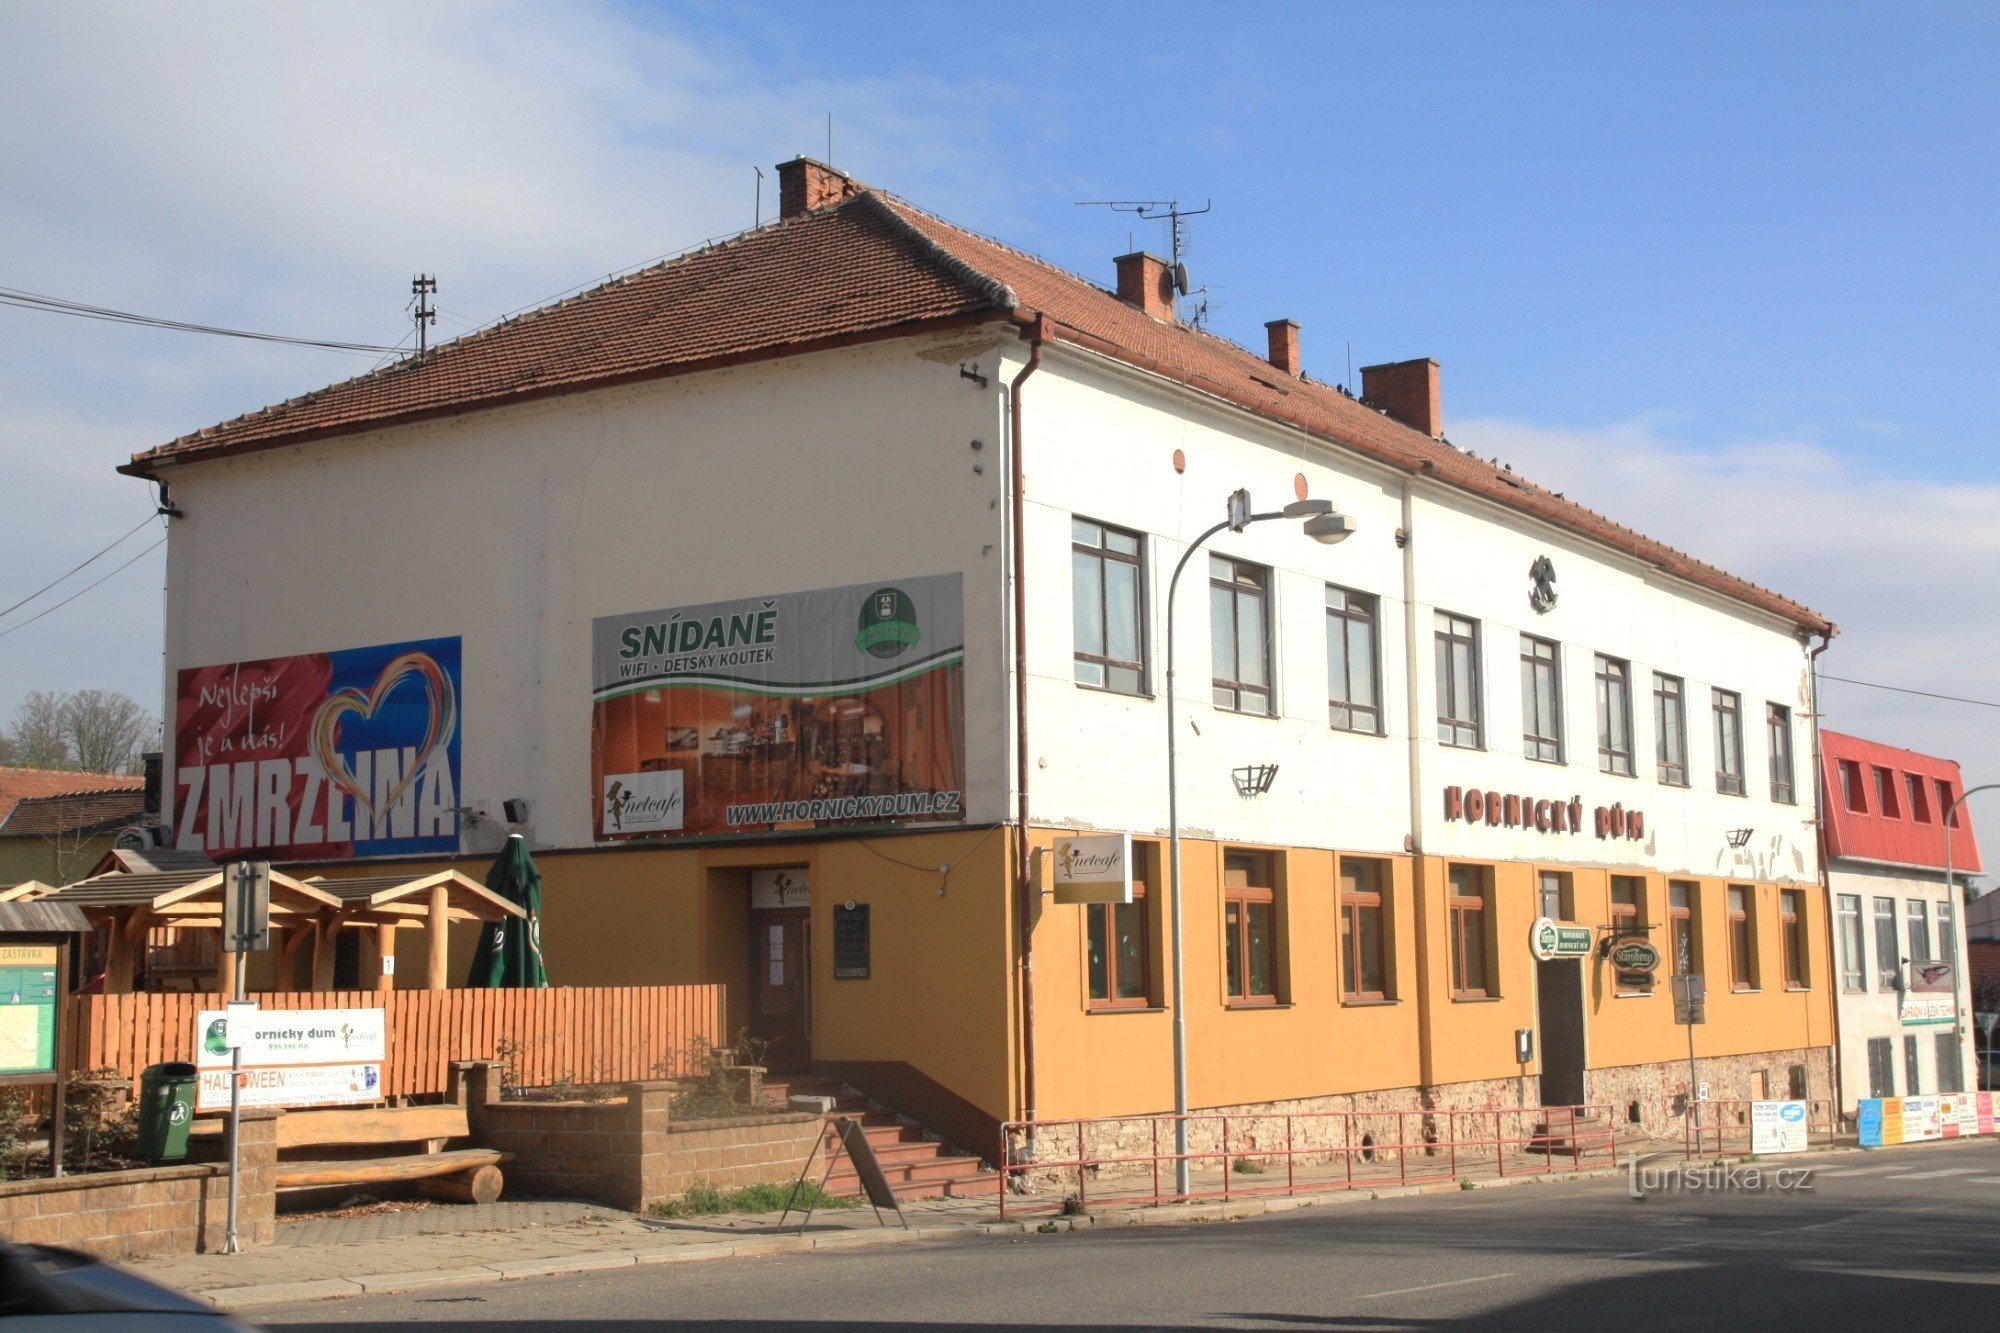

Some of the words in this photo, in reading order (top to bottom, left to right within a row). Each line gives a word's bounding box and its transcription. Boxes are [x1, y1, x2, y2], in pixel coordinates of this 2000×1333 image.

[618, 600, 778, 659] SNÍDANĚ
[619, 662, 648, 678] WIFI
[663, 651, 718, 673] DĚTSKÝ
[719, 647, 775, 667] KOUTEK
[200, 662, 279, 734] Nejlepší
[198, 725, 213, 767] je
[220, 738, 234, 752] u
[242, 722, 284, 750] nás!
[175, 747, 455, 850] ZMRZLINA
[726, 791, 961, 825] WWW.HORNICKYDUM.CZ
[1444, 786, 1583, 835] HORNICKÝ
[1594, 802, 1645, 841] DŮM
[1074, 848, 1121, 873] netcafe
[2, 947, 43, 959] ZASTÁVKA
[1616, 949, 1653, 962] Starobrno
[203, 1071, 286, 1091] HALOWEEN
